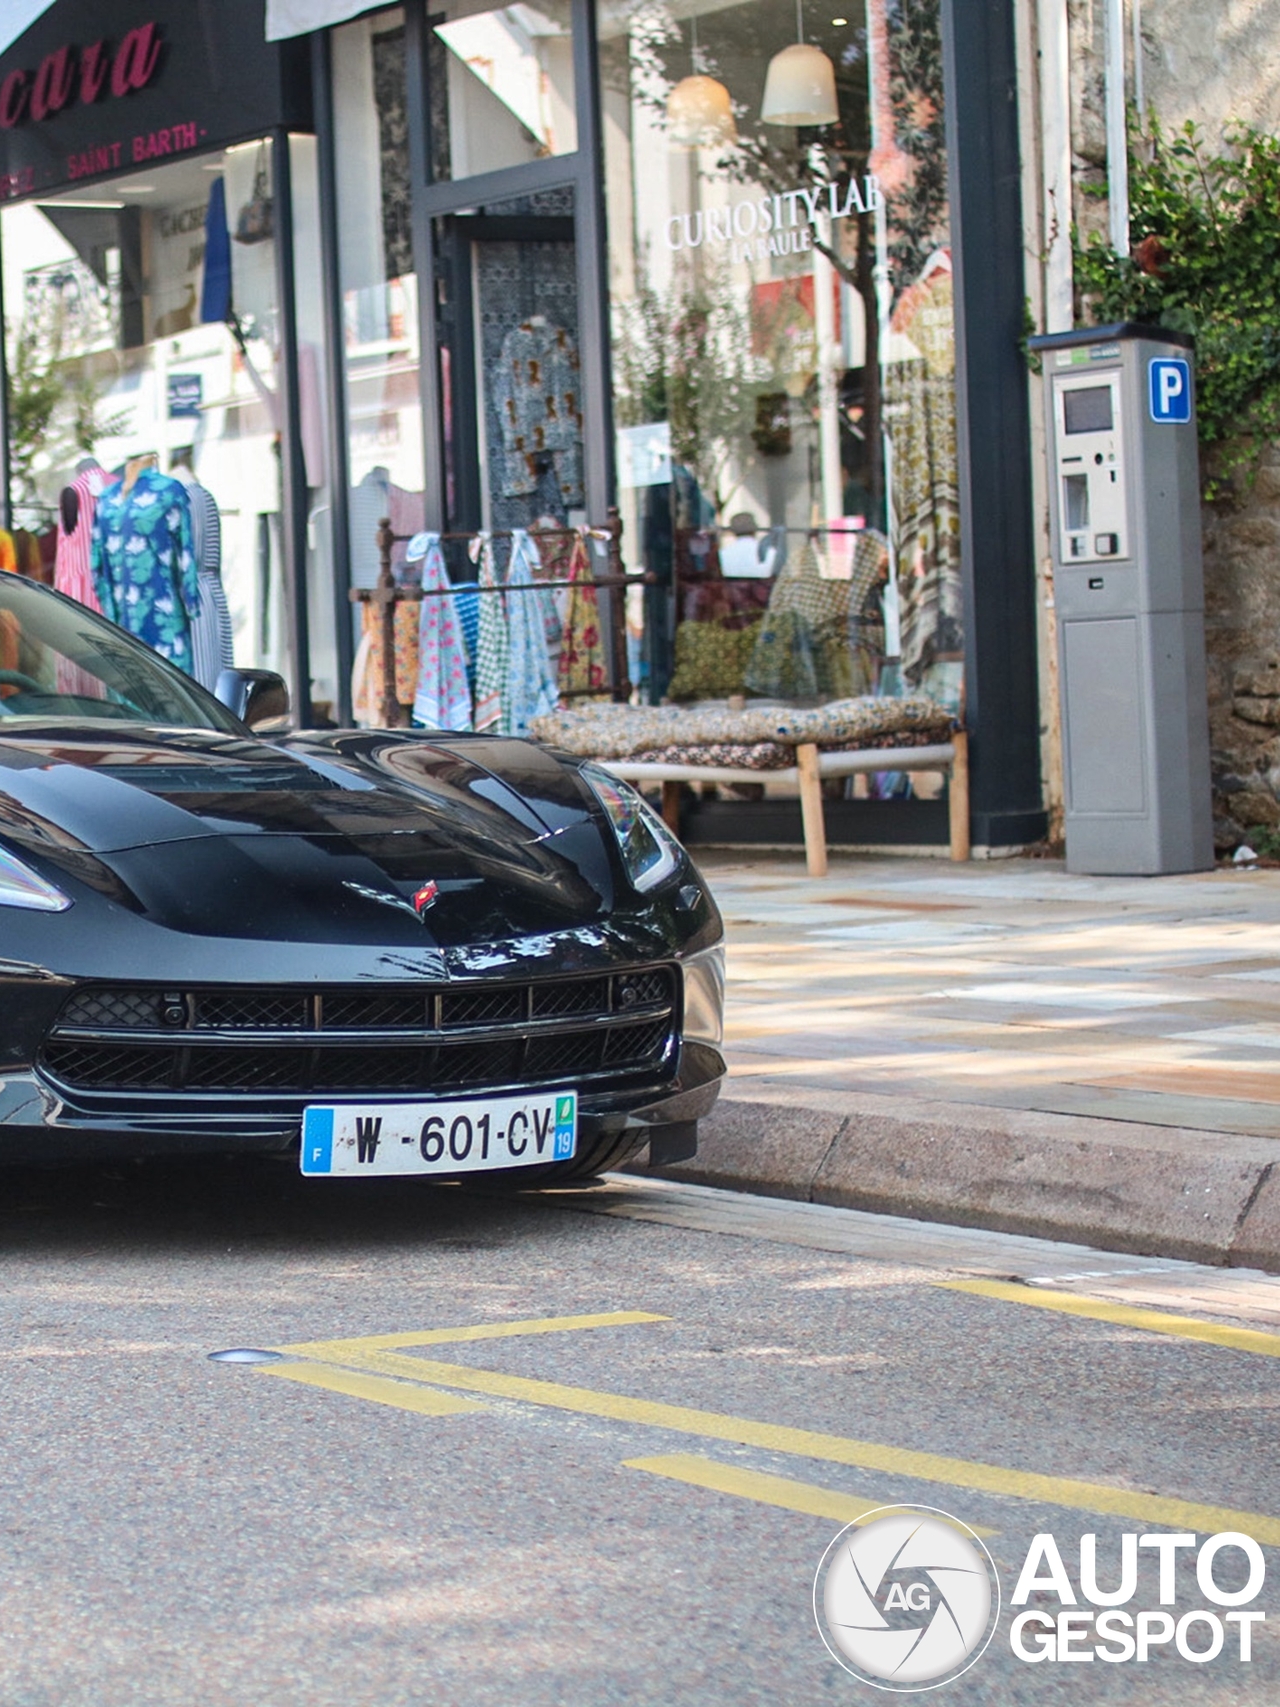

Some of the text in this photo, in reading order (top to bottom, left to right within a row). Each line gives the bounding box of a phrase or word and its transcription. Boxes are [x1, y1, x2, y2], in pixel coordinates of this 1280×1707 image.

[663, 174, 883, 250] CURIOSITY LAB
[756, 229, 812, 259] BAULE
[1159, 366, 1183, 414] P
[312, 1148, 322, 1163] F
[557, 1131, 571, 1154] 19
